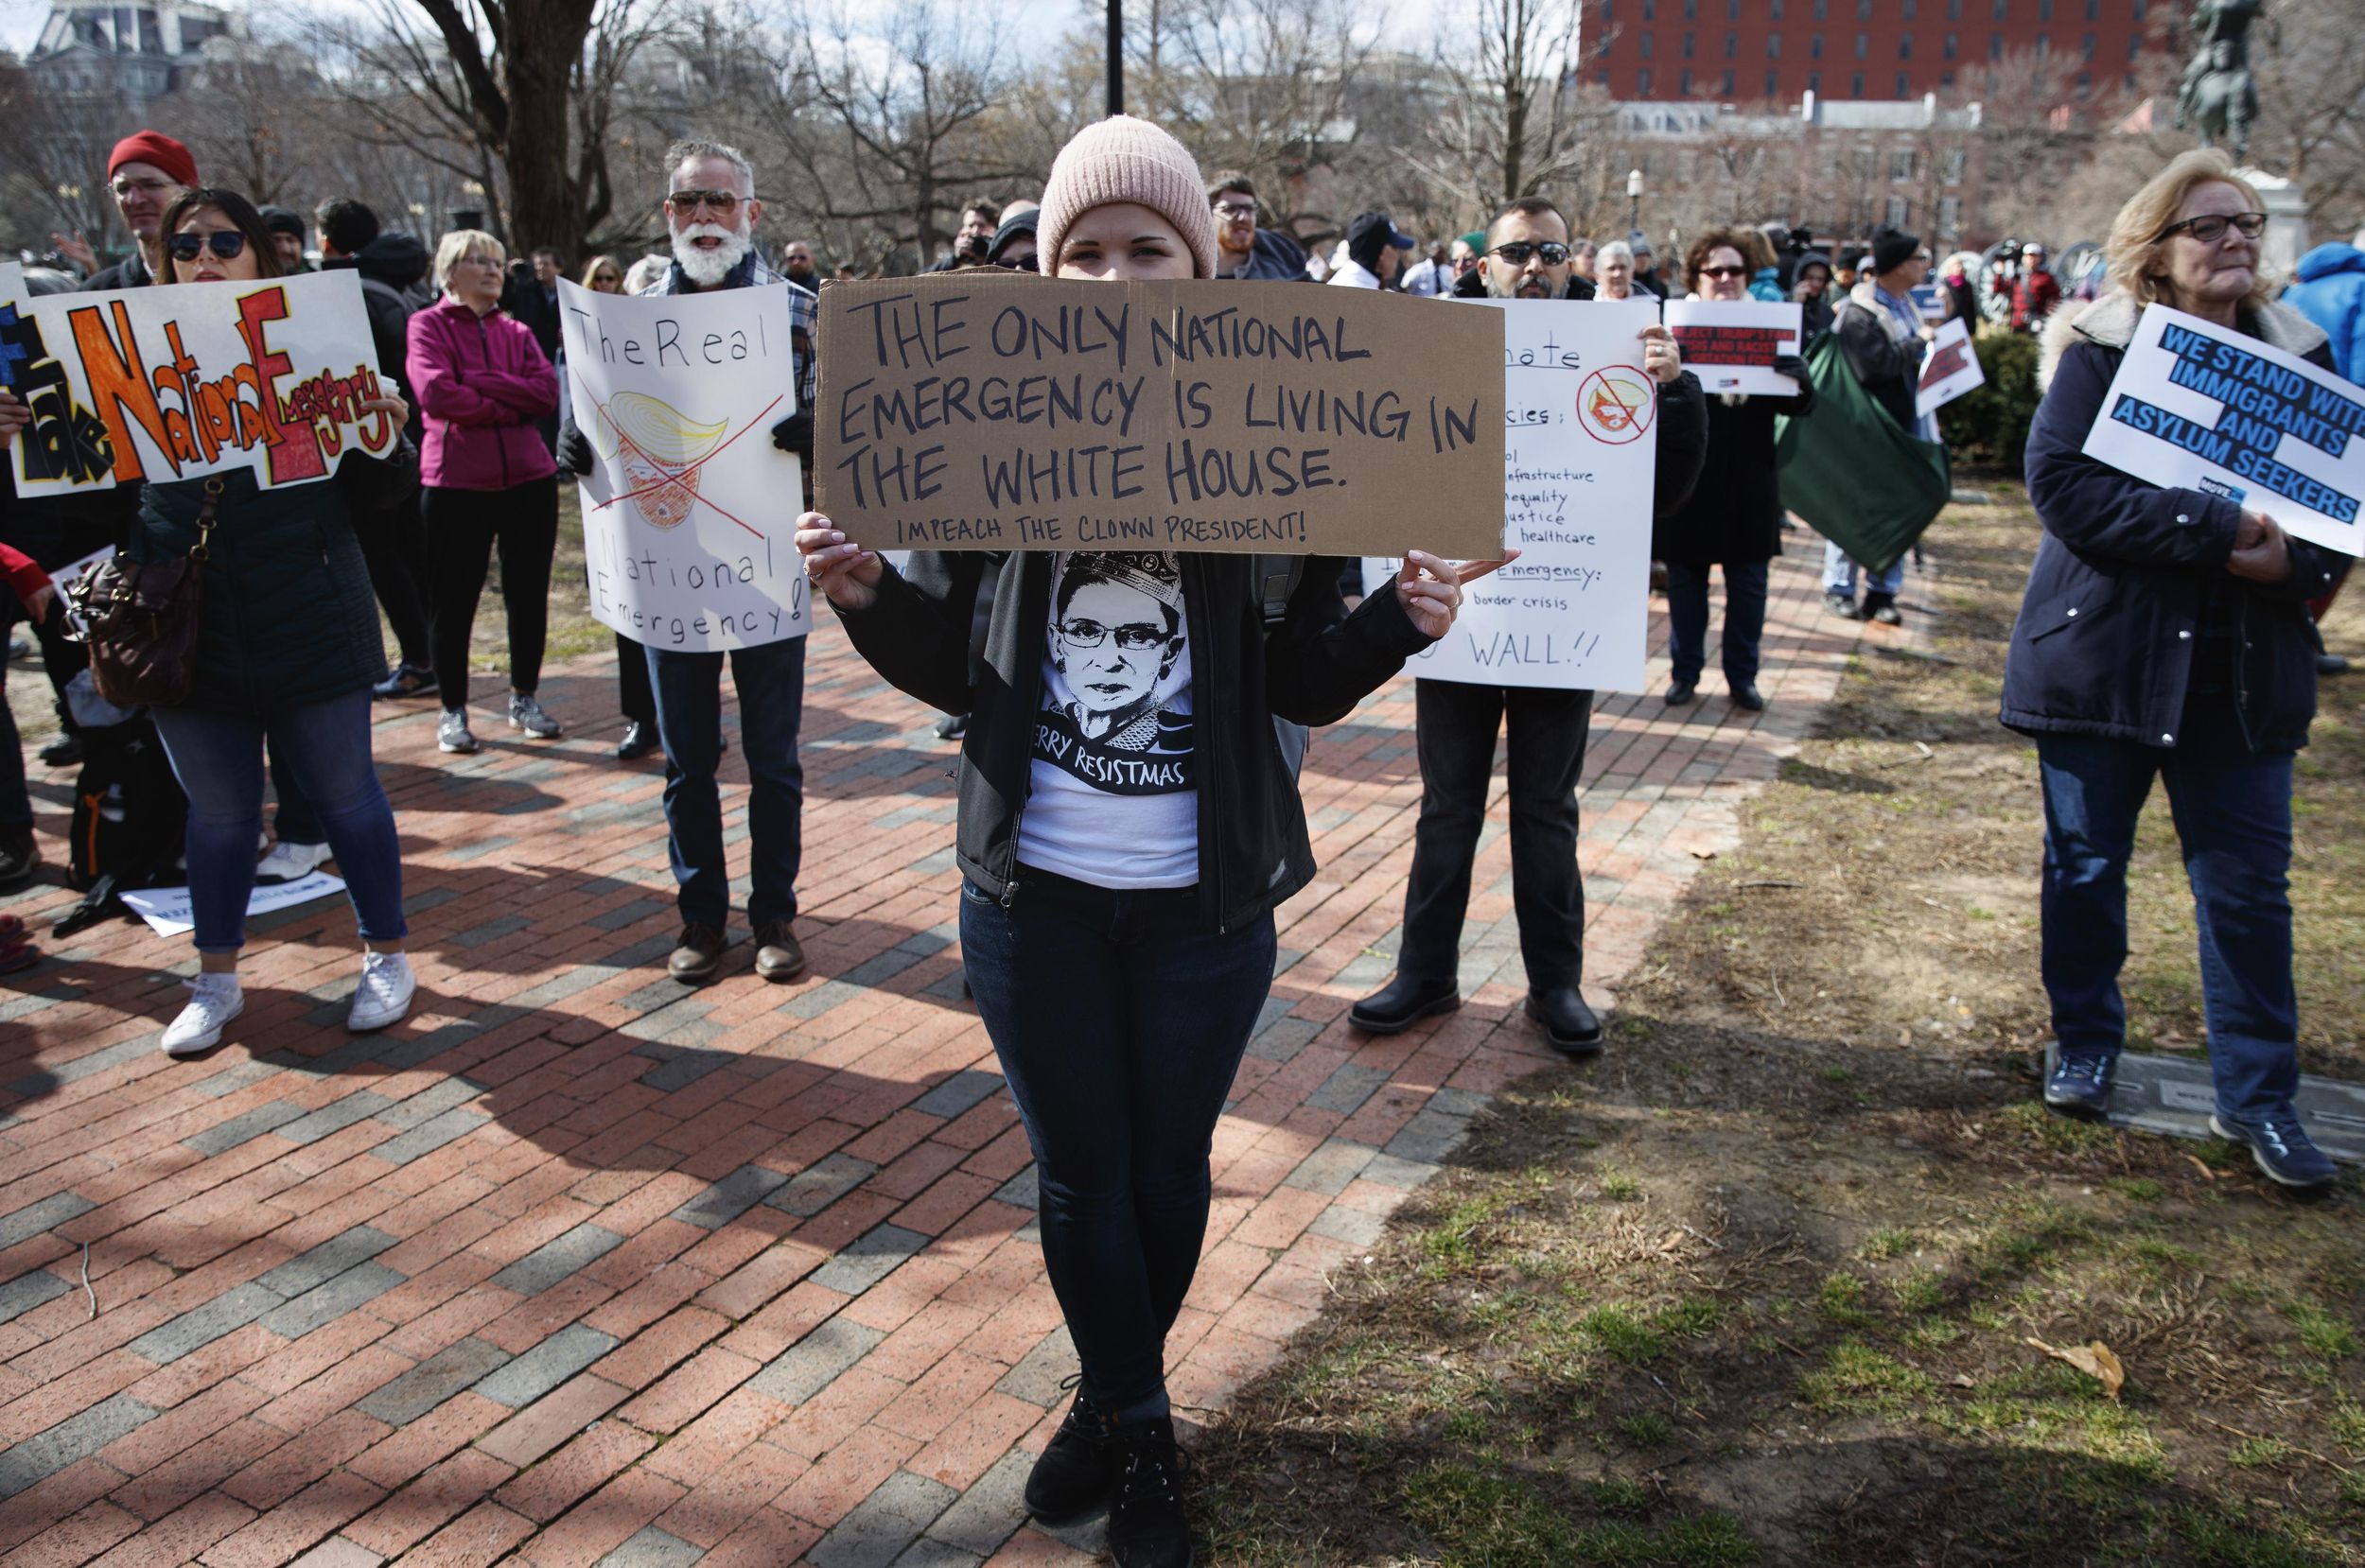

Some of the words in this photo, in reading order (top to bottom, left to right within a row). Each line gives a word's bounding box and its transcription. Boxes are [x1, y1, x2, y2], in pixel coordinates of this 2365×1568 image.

[847, 294, 971, 368] THE
[991, 303, 1130, 373] ONLY
[1150, 305, 1372, 367] NATIONAL
[2162, 324, 2212, 361] WE
[2211, 347, 2305, 400] STAND
[839, 374, 1145, 444] EMERGENCY
[1175, 379, 1213, 428] IS
[1246, 383, 1410, 442] LIVING
[1430, 395, 1478, 453] IN
[2170, 359, 2348, 456] IMMIGRANTS
[2216, 412, 2280, 453] AND
[836, 444, 948, 509] THE
[983, 444, 1145, 509] WHITE
[1165, 439, 1347, 504] HOUSE.
[2113, 398, 2232, 464] ASYLUM
[2233, 449, 2356, 522] SEEKERS
[602, 530, 773, 590] National
[898, 515, 1002, 544] IMPEACH
[1015, 515, 1063, 543] THE
[1078, 515, 1154, 543] CLOWN
[1165, 511, 1306, 543] PRESIDENT!
[1520, 528, 1596, 545] healthcare
[598, 570, 802, 644] Emergency!
[1474, 593, 1516, 606] border
[1522, 596, 1568, 611] crisis
[1469, 631, 1600, 668] WALL!!
[1034, 724, 1072, 759] RRY
[1075, 745, 1184, 787] RESISTMAS
